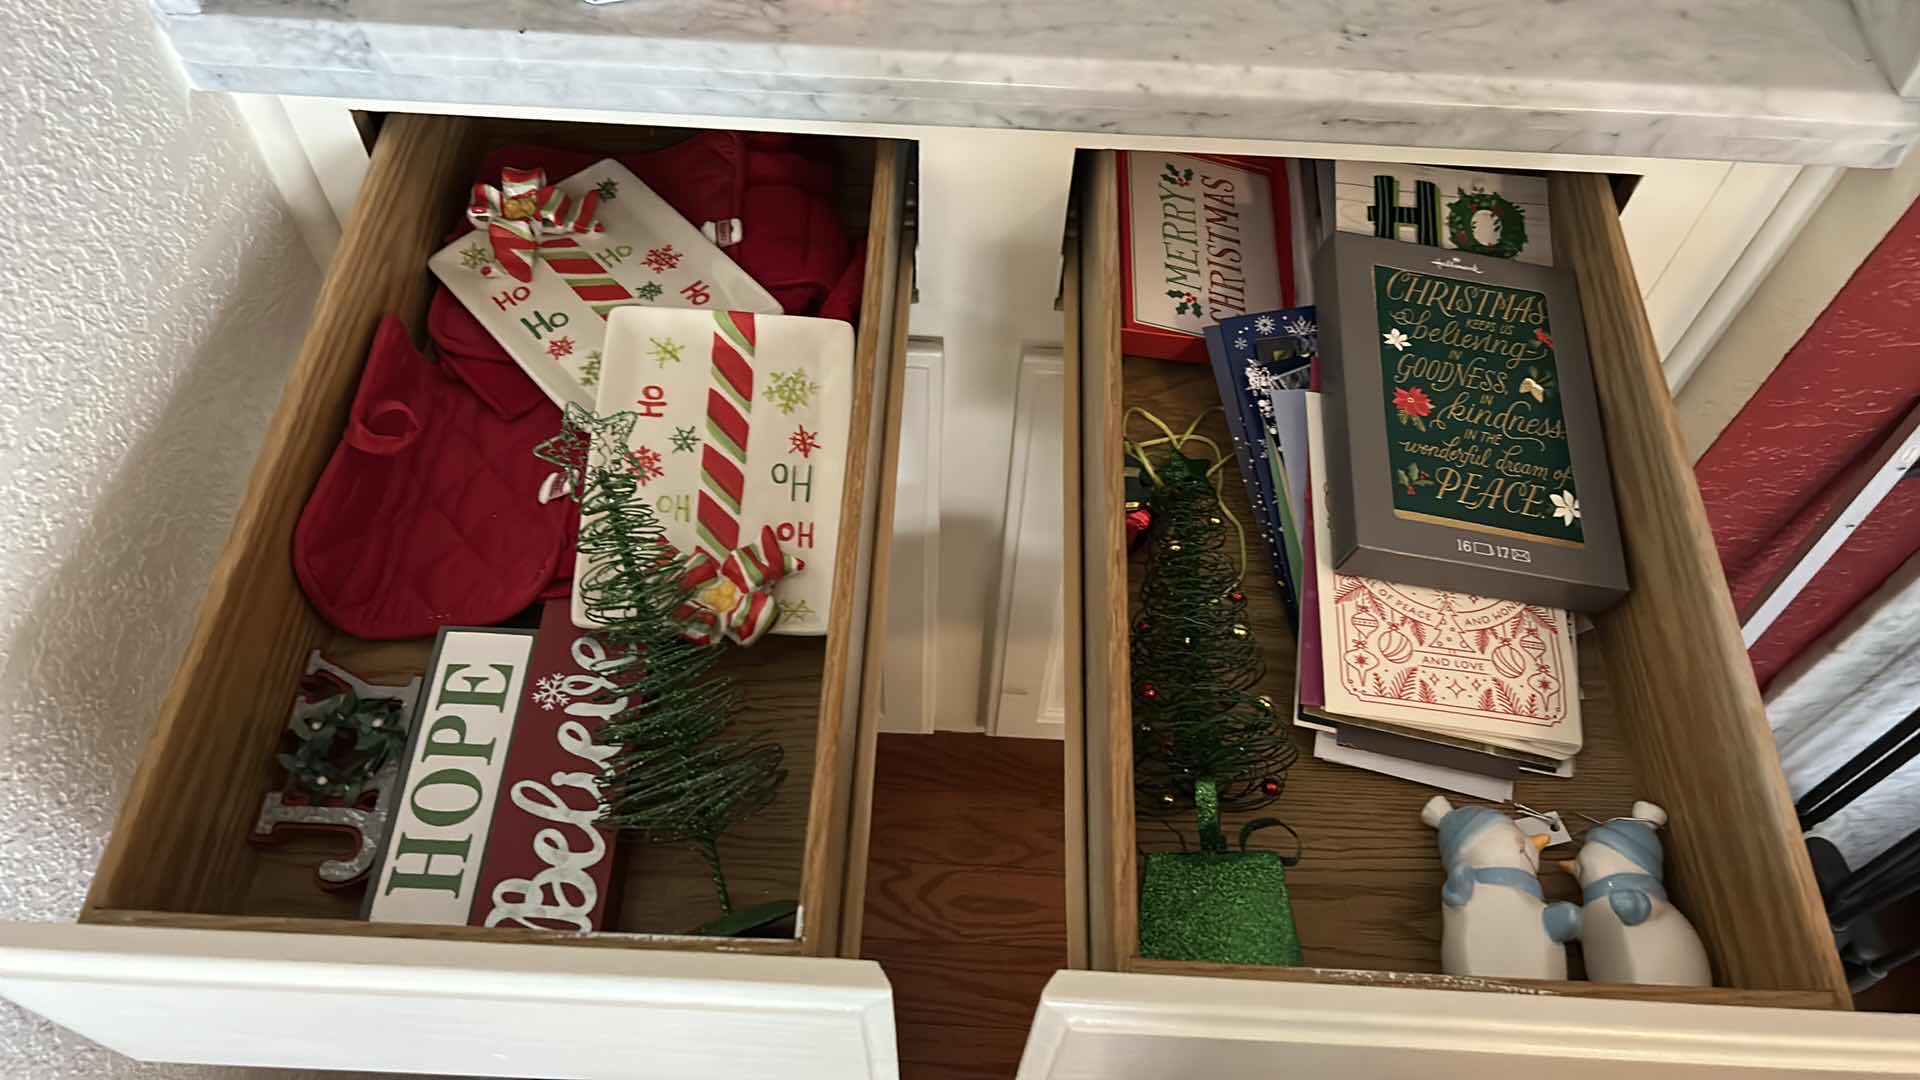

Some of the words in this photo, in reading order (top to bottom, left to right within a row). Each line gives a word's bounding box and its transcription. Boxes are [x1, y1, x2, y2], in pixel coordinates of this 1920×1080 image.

[1158, 183, 1201, 292] MERRY
[1200, 175, 1246, 323] CHRISTMAS
[1386, 270, 1550, 325] CHRISTMAS
[1391, 308, 1549, 369] believing
[1399, 436, 1488, 468] wonderful
[1496, 445, 1549, 480] dream
[1552, 466, 1571, 489] of
[1456, 538, 1472, 553] 16
[1496, 545, 1510, 559] 17
[1396, 599, 1432, 621] PEACE
[1465, 615, 1490, 626] AND
[1421, 655, 1451, 667] AND
[1454, 658, 1485, 671] LOVE
[385, 663, 514, 899] HOPE
